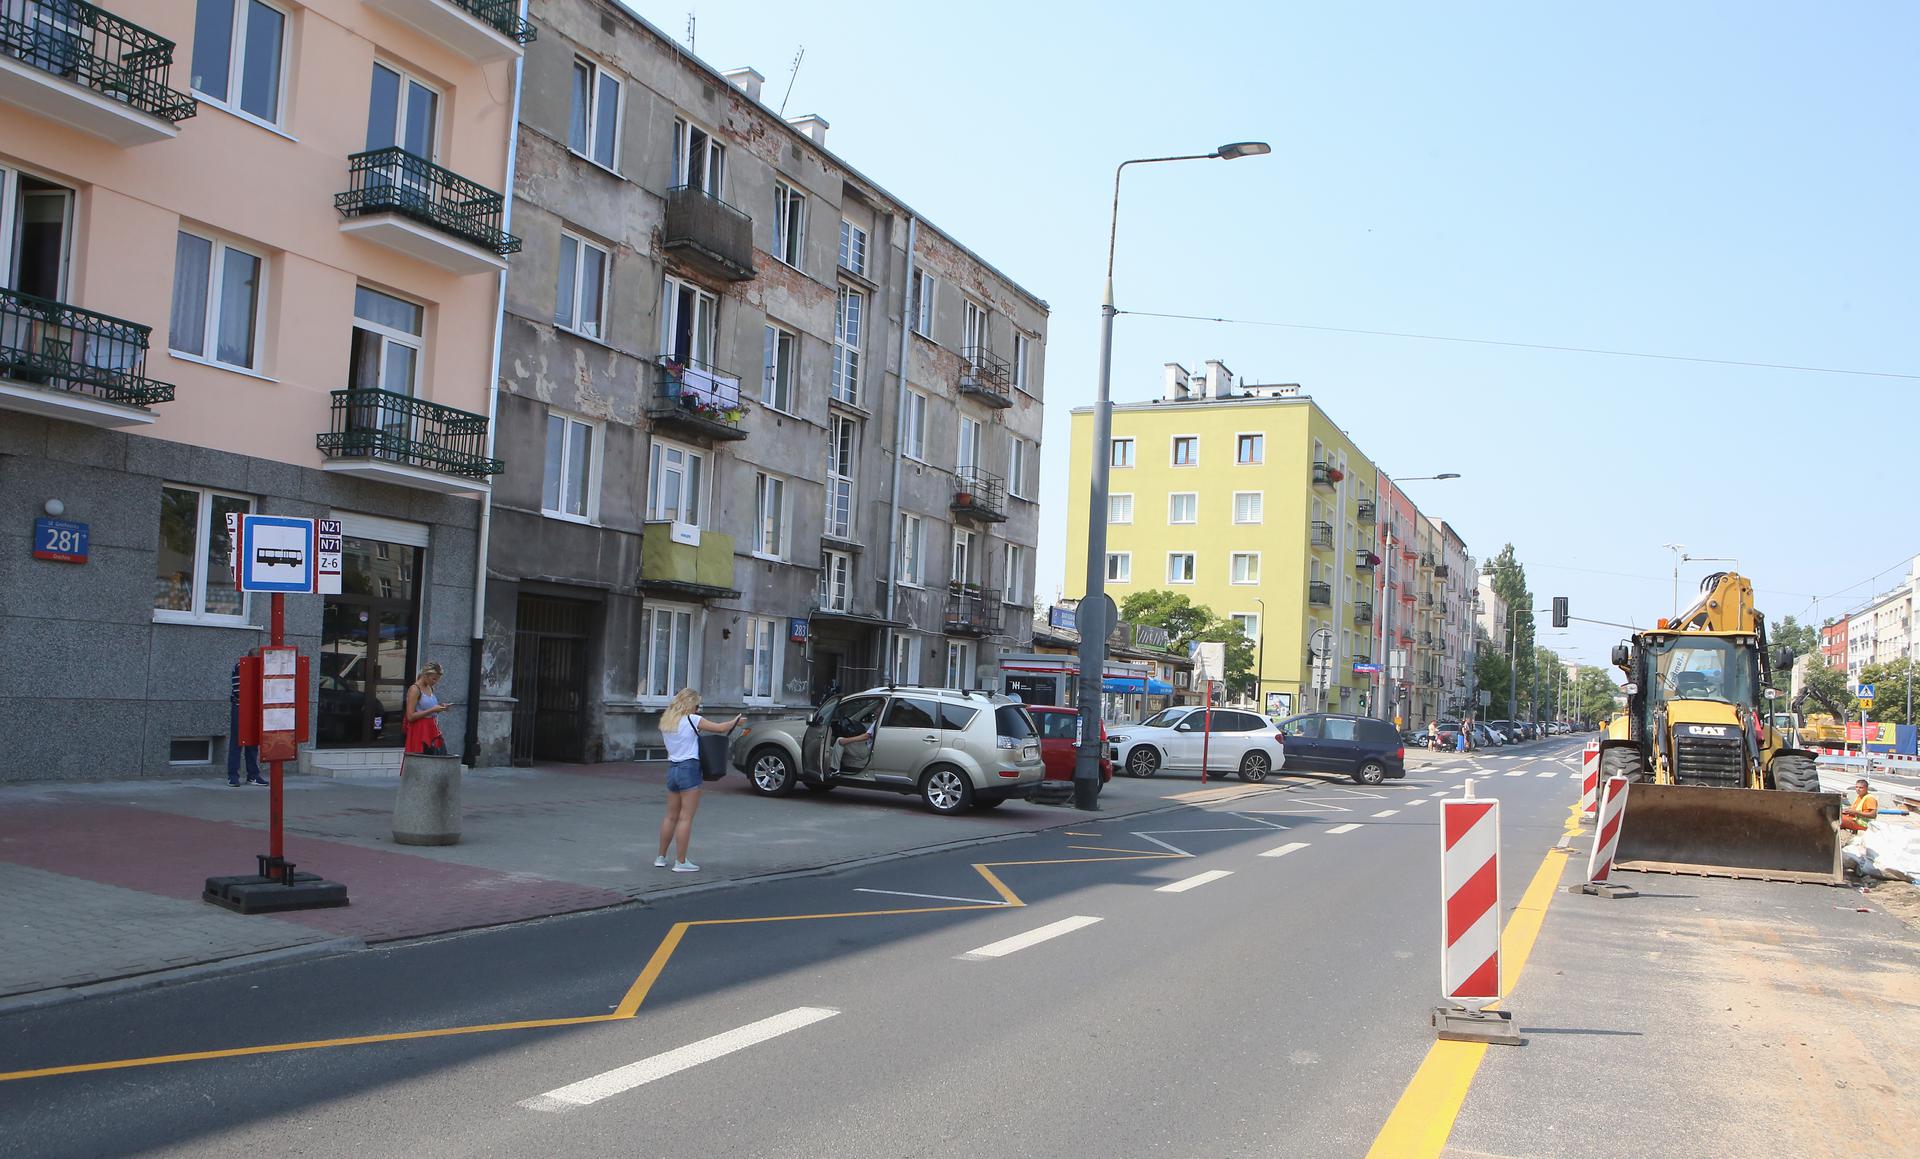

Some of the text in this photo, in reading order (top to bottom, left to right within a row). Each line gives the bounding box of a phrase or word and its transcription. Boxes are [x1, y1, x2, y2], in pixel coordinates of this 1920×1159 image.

[321, 521, 340, 533] N21
[46, 528, 80, 553] 281
[321, 538, 339, 550] N71
[321, 558, 338, 569] Z-6
[794, 624, 806, 637] 283
[1688, 725, 1727, 736] CAT
